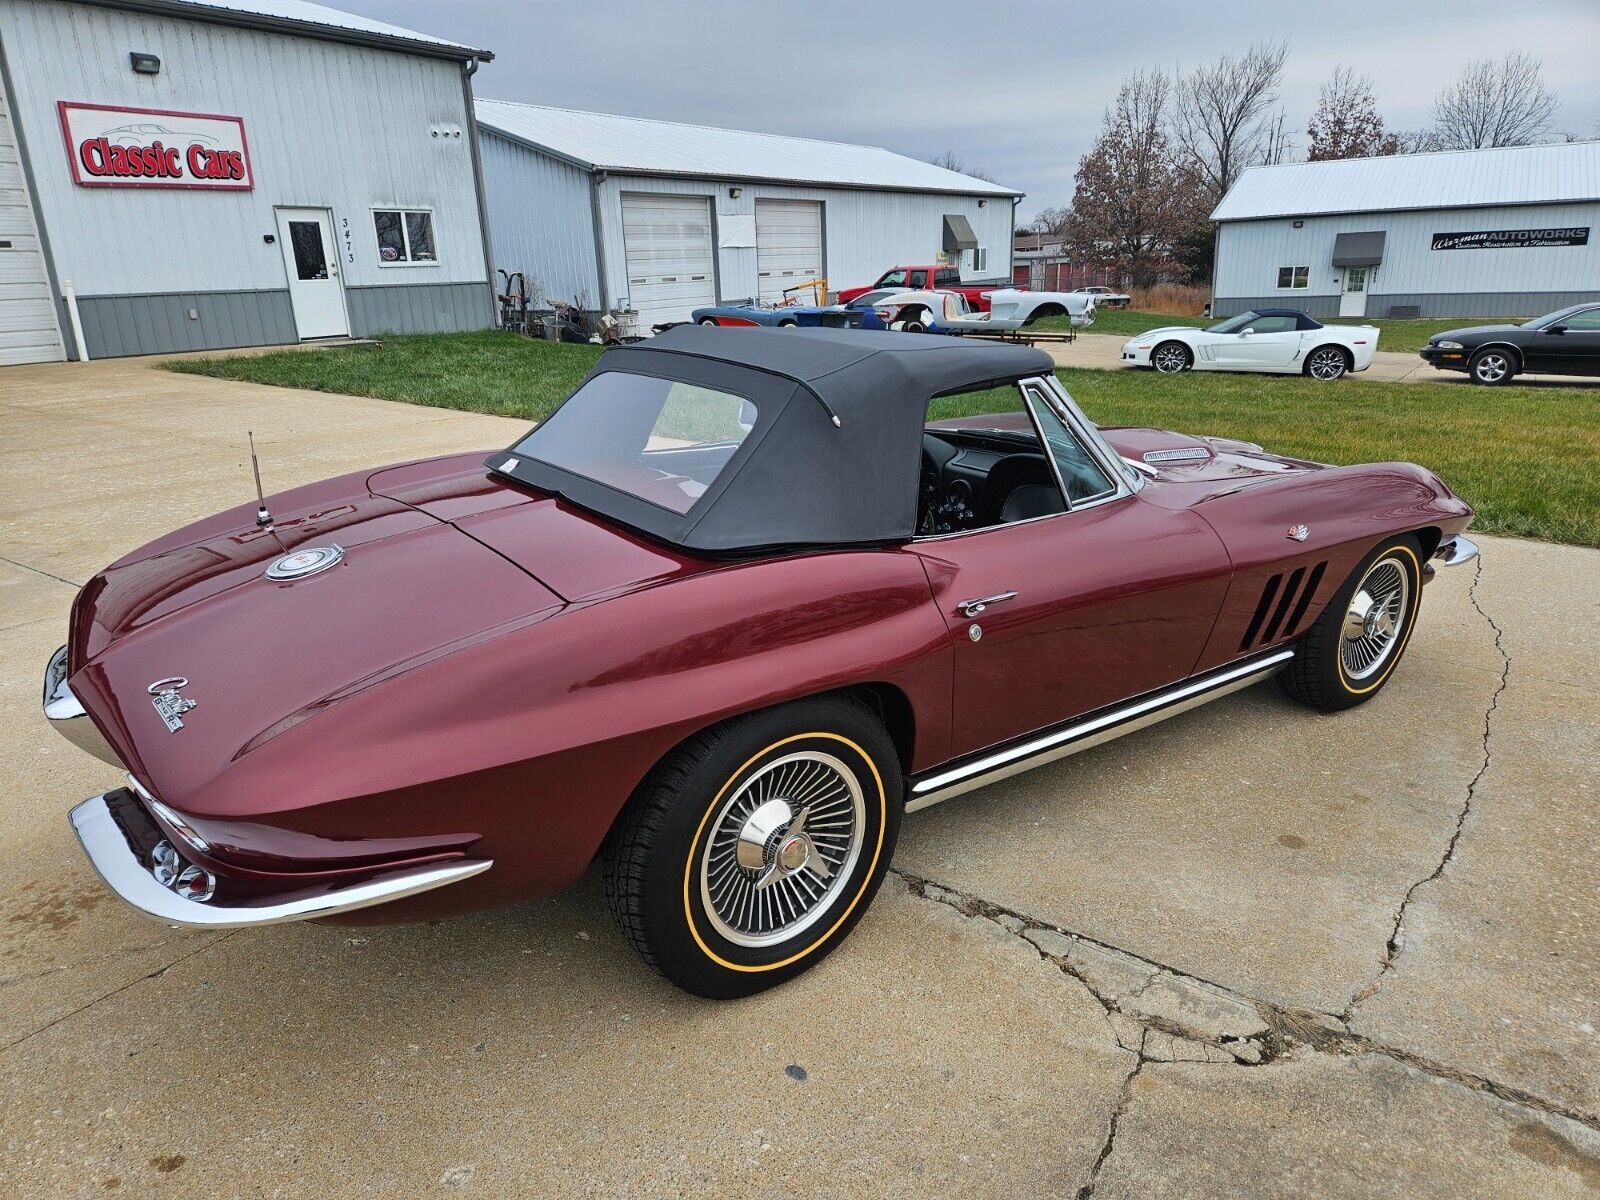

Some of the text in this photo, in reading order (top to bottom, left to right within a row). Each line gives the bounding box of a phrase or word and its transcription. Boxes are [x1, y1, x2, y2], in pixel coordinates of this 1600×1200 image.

[80, 137, 245, 180] Classic Cars
[342, 218, 354, 263] 3473
[1433, 228, 1587, 250] Warman AUTOWORKS
[1530, 239, 1570, 247] Fabrication
